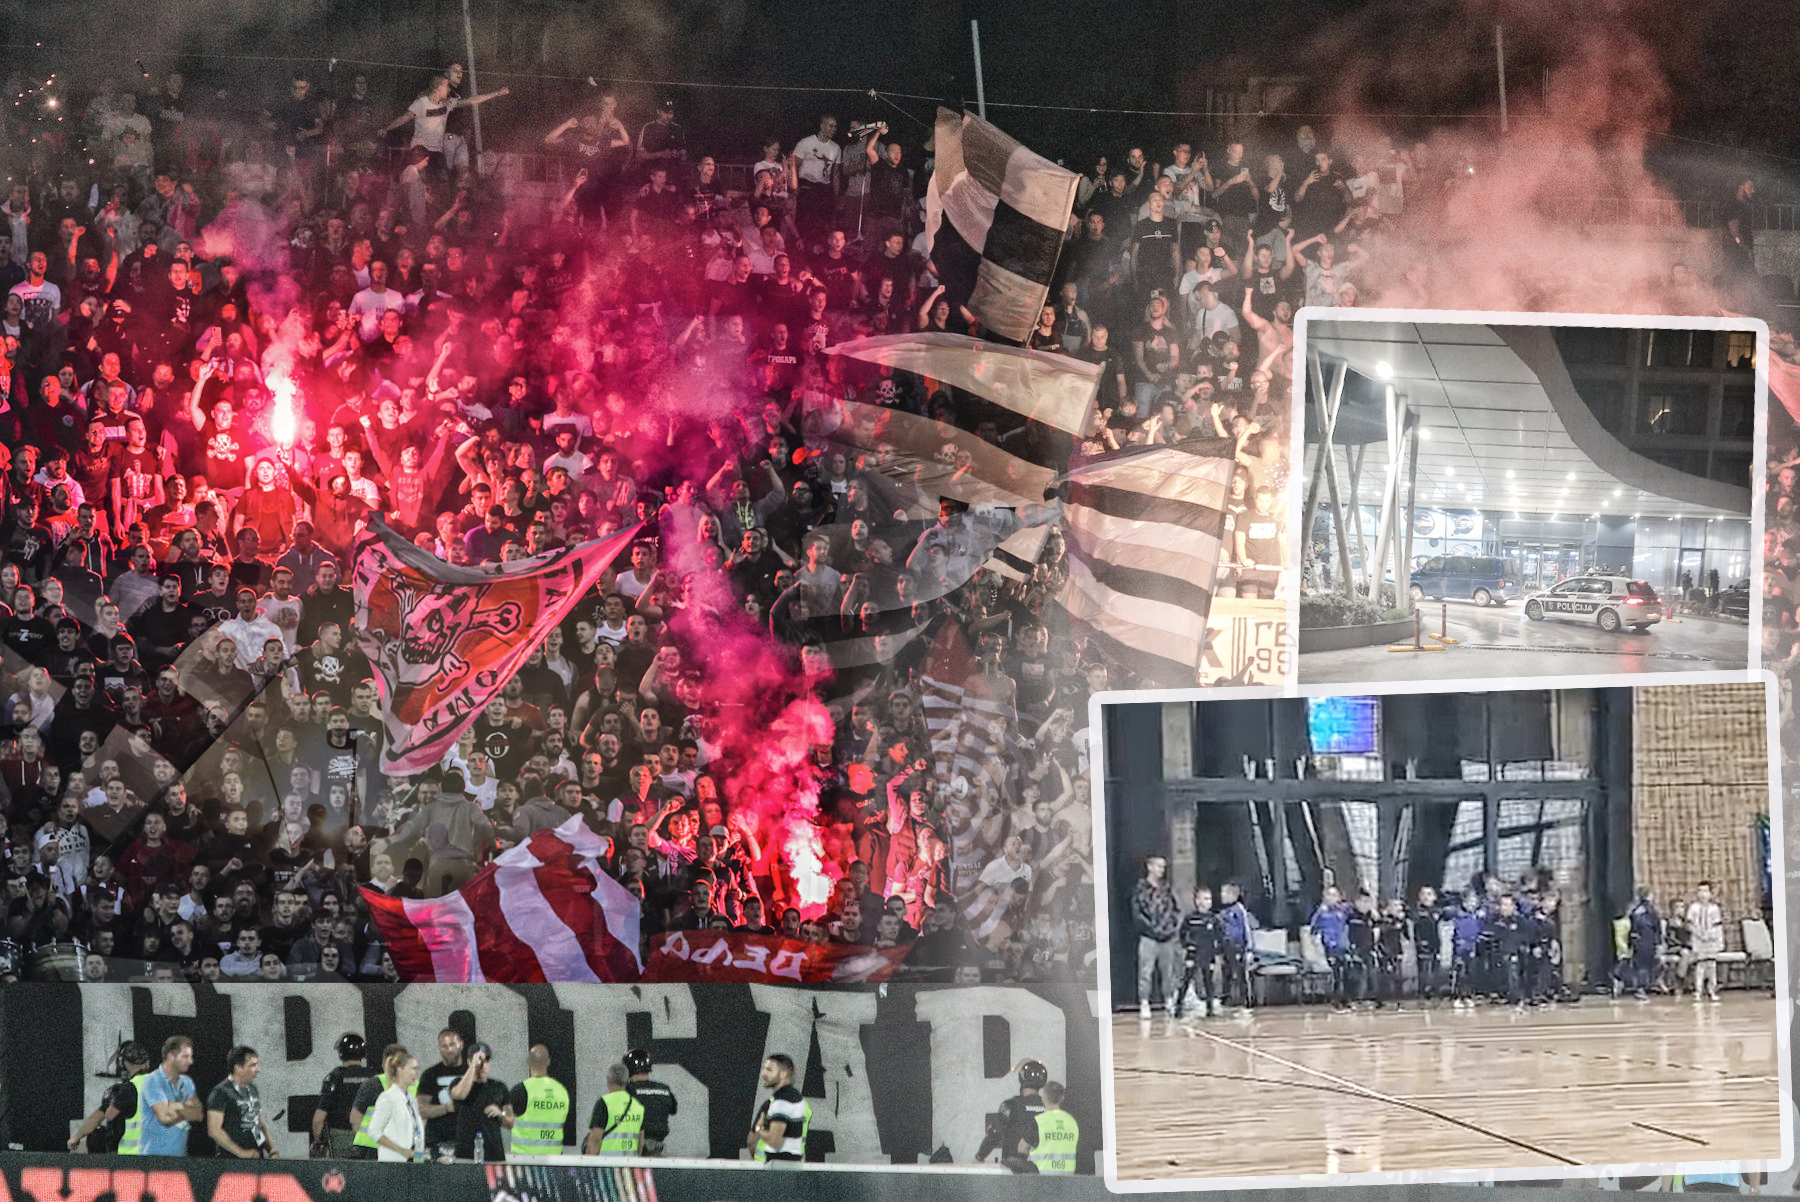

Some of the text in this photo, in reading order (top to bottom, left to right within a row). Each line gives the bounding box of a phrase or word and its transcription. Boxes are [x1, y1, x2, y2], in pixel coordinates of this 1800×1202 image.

[1556, 602, 1593, 612] POLICIJA
[534, 1100, 565, 1110] REDAR
[540, 1129, 555, 1139] 092
[1044, 1132, 1075, 1141] REDAR
[1051, 1160, 1066, 1169] 069
